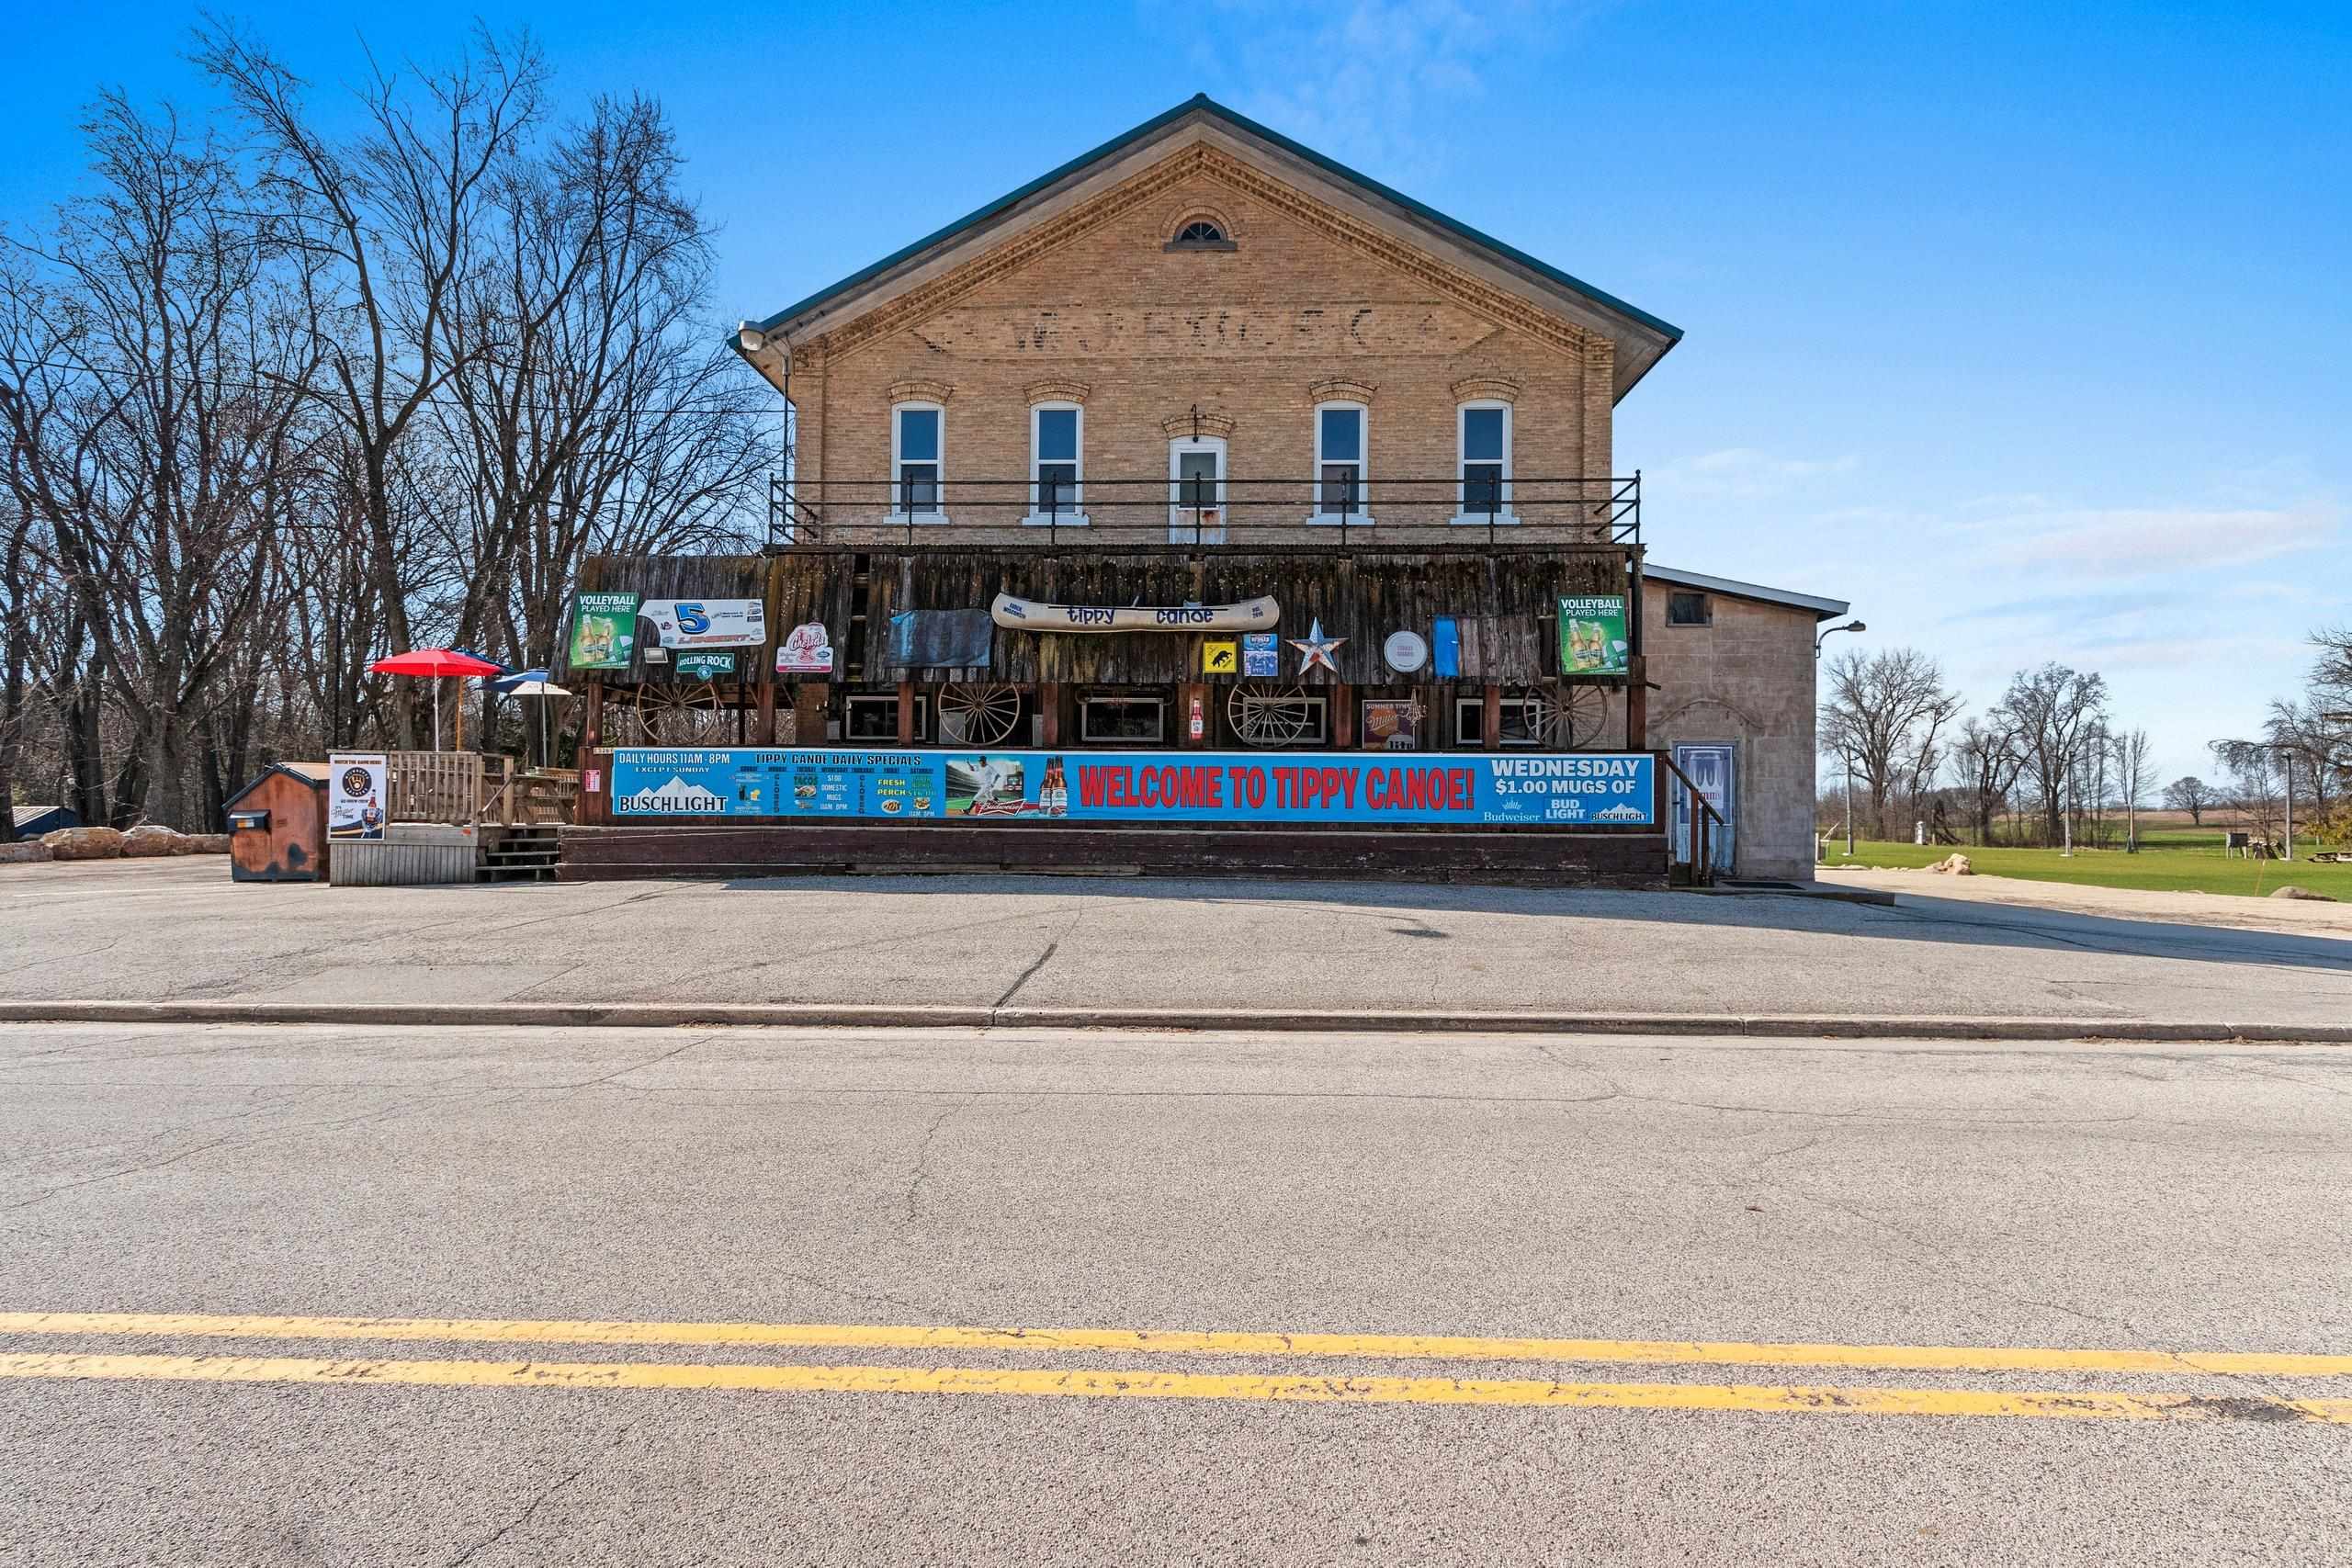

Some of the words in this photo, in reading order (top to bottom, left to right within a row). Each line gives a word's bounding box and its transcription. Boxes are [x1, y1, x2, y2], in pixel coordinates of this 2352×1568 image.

[579, 595, 636, 605] VOLLEYBALL
[1560, 598, 1623, 609] VOLLEYBALL
[673, 603, 711, 635] 5
[1067, 607, 1115, 625] tippy
[1156, 608, 1214, 625] canoe
[679, 655, 706, 666] ROLLING
[707, 655, 732, 670] ROCK
[1365, 714, 1398, 732] Miller
[619, 752, 646, 764] DAILY
[647, 752, 678, 764] HOURS
[680, 753, 703, 764] 11AM
[708, 753, 730, 764] 8PM
[756, 753, 787, 764] TIPPY
[832, 754, 864, 765] DAILY
[866, 755, 922, 765] SPECIALS
[1491, 760, 1640, 777] WEDNESDAY
[1078, 764, 1223, 808] WELCOME
[1228, 766, 1267, 809] TO
[1272, 766, 1361, 810] TIPPY
[1365, 767, 1476, 811] CANOE!
[1495, 779, 1547, 795] $1.00
[1552, 780, 1608, 795] MUGS
[1611, 780, 1636, 794] OF
[618, 796, 672, 812] BUSCH
[673, 796, 728, 811] LIGHT
[1551, 799, 1579, 809] BUD
[1484, 812, 1541, 821] Budweiser
[1545, 809, 1586, 819] LIGHT
[1591, 812, 1620, 821] BUSCH
[1620, 812, 1647, 821] LIGHT
